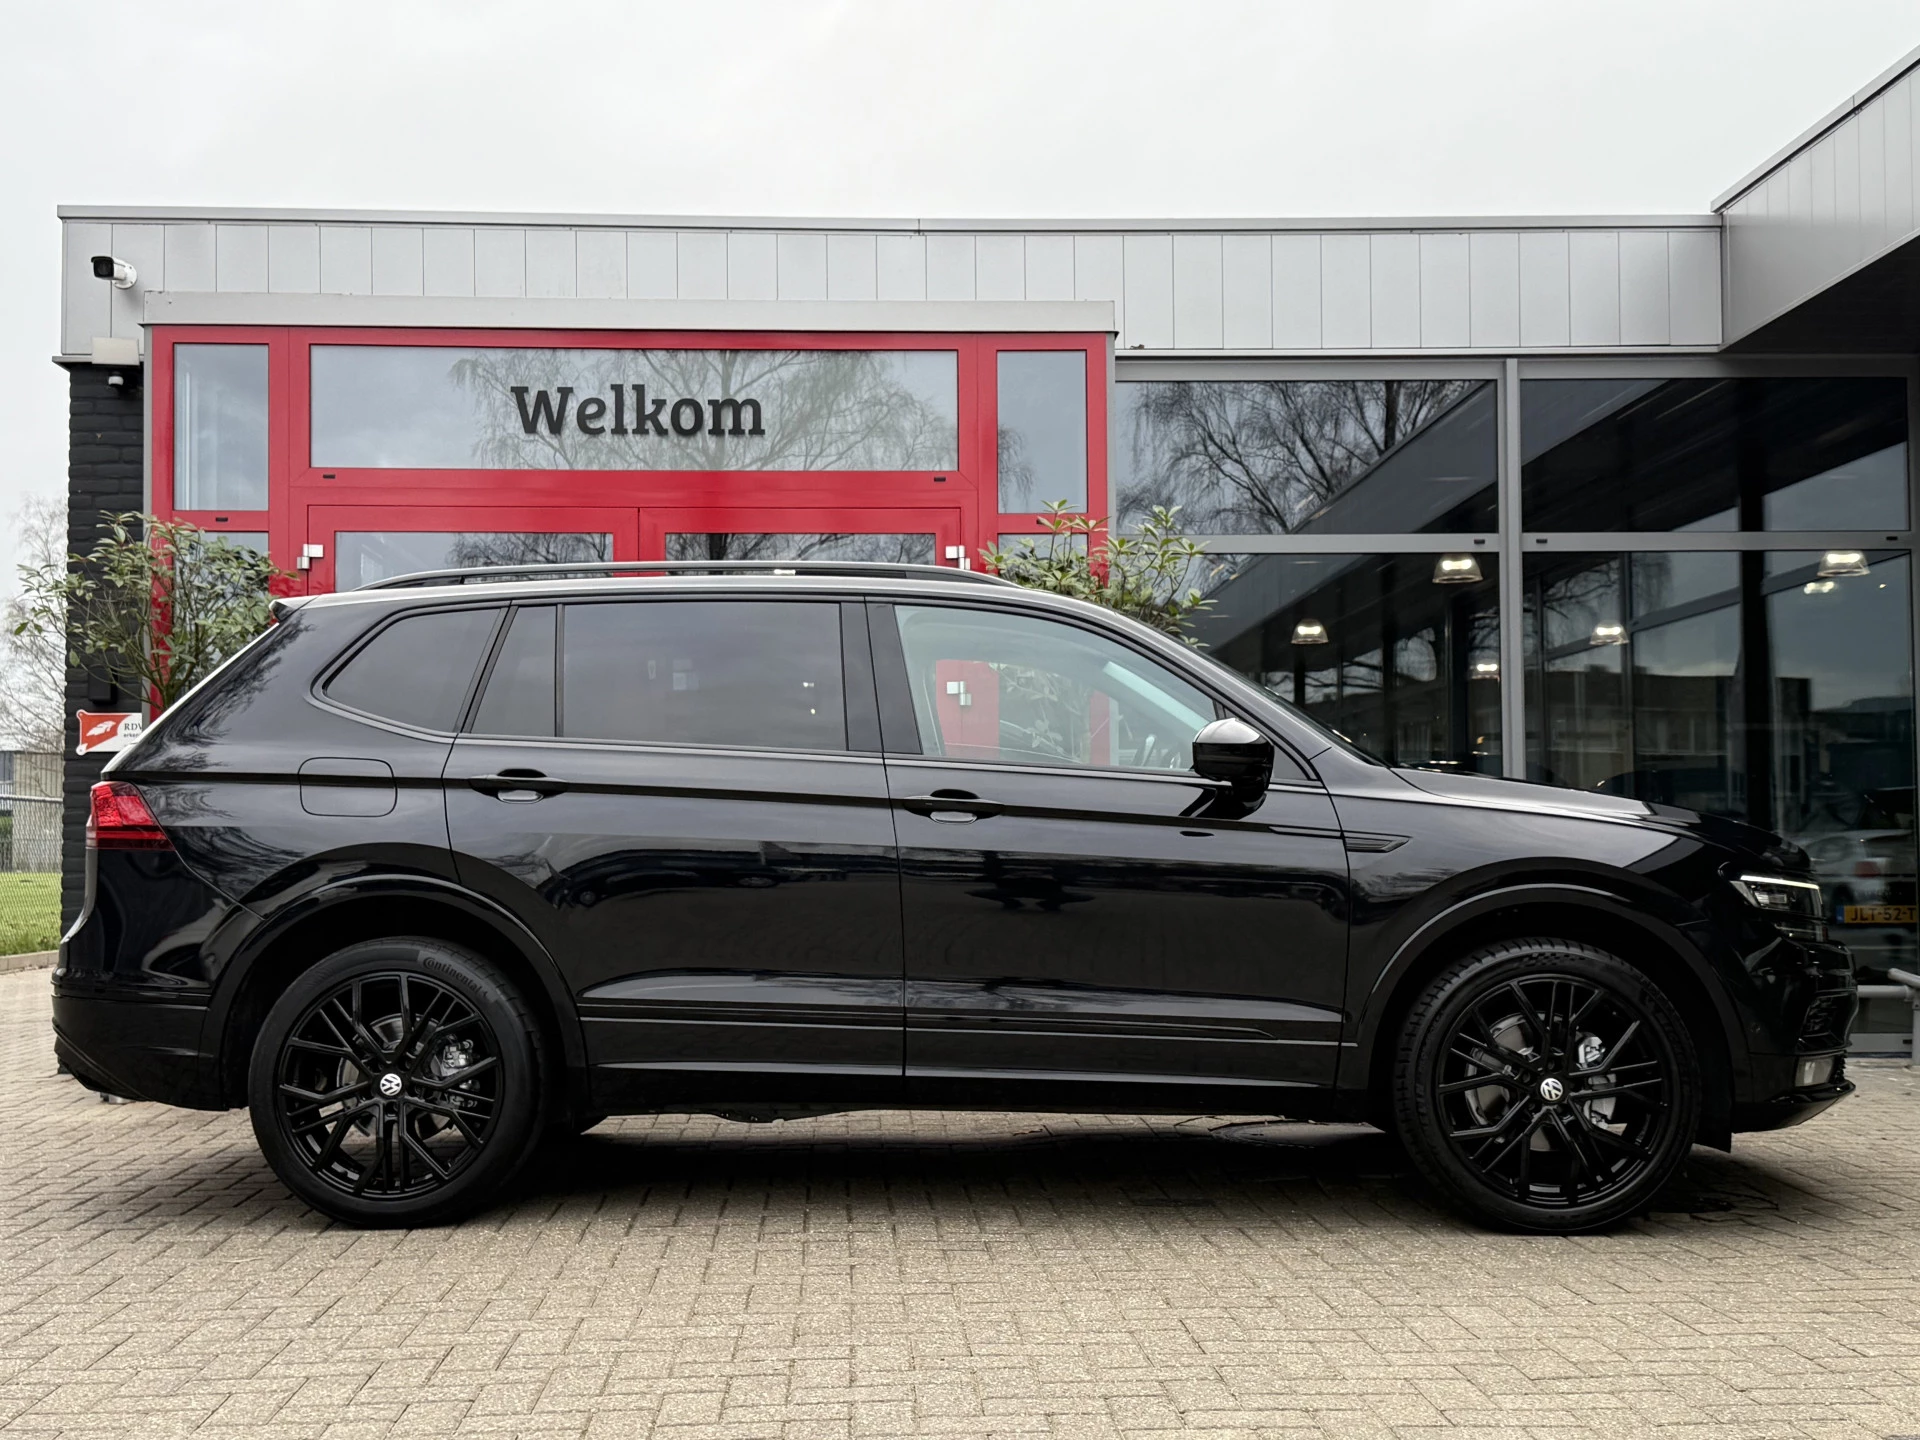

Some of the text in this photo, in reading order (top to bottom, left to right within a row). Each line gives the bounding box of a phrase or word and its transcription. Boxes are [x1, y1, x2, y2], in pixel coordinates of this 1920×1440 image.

[510, 383, 765, 436] Welkom
[1851, 906, 1916, 921] JLT-52-T
[422, 956, 482, 994] Continental
